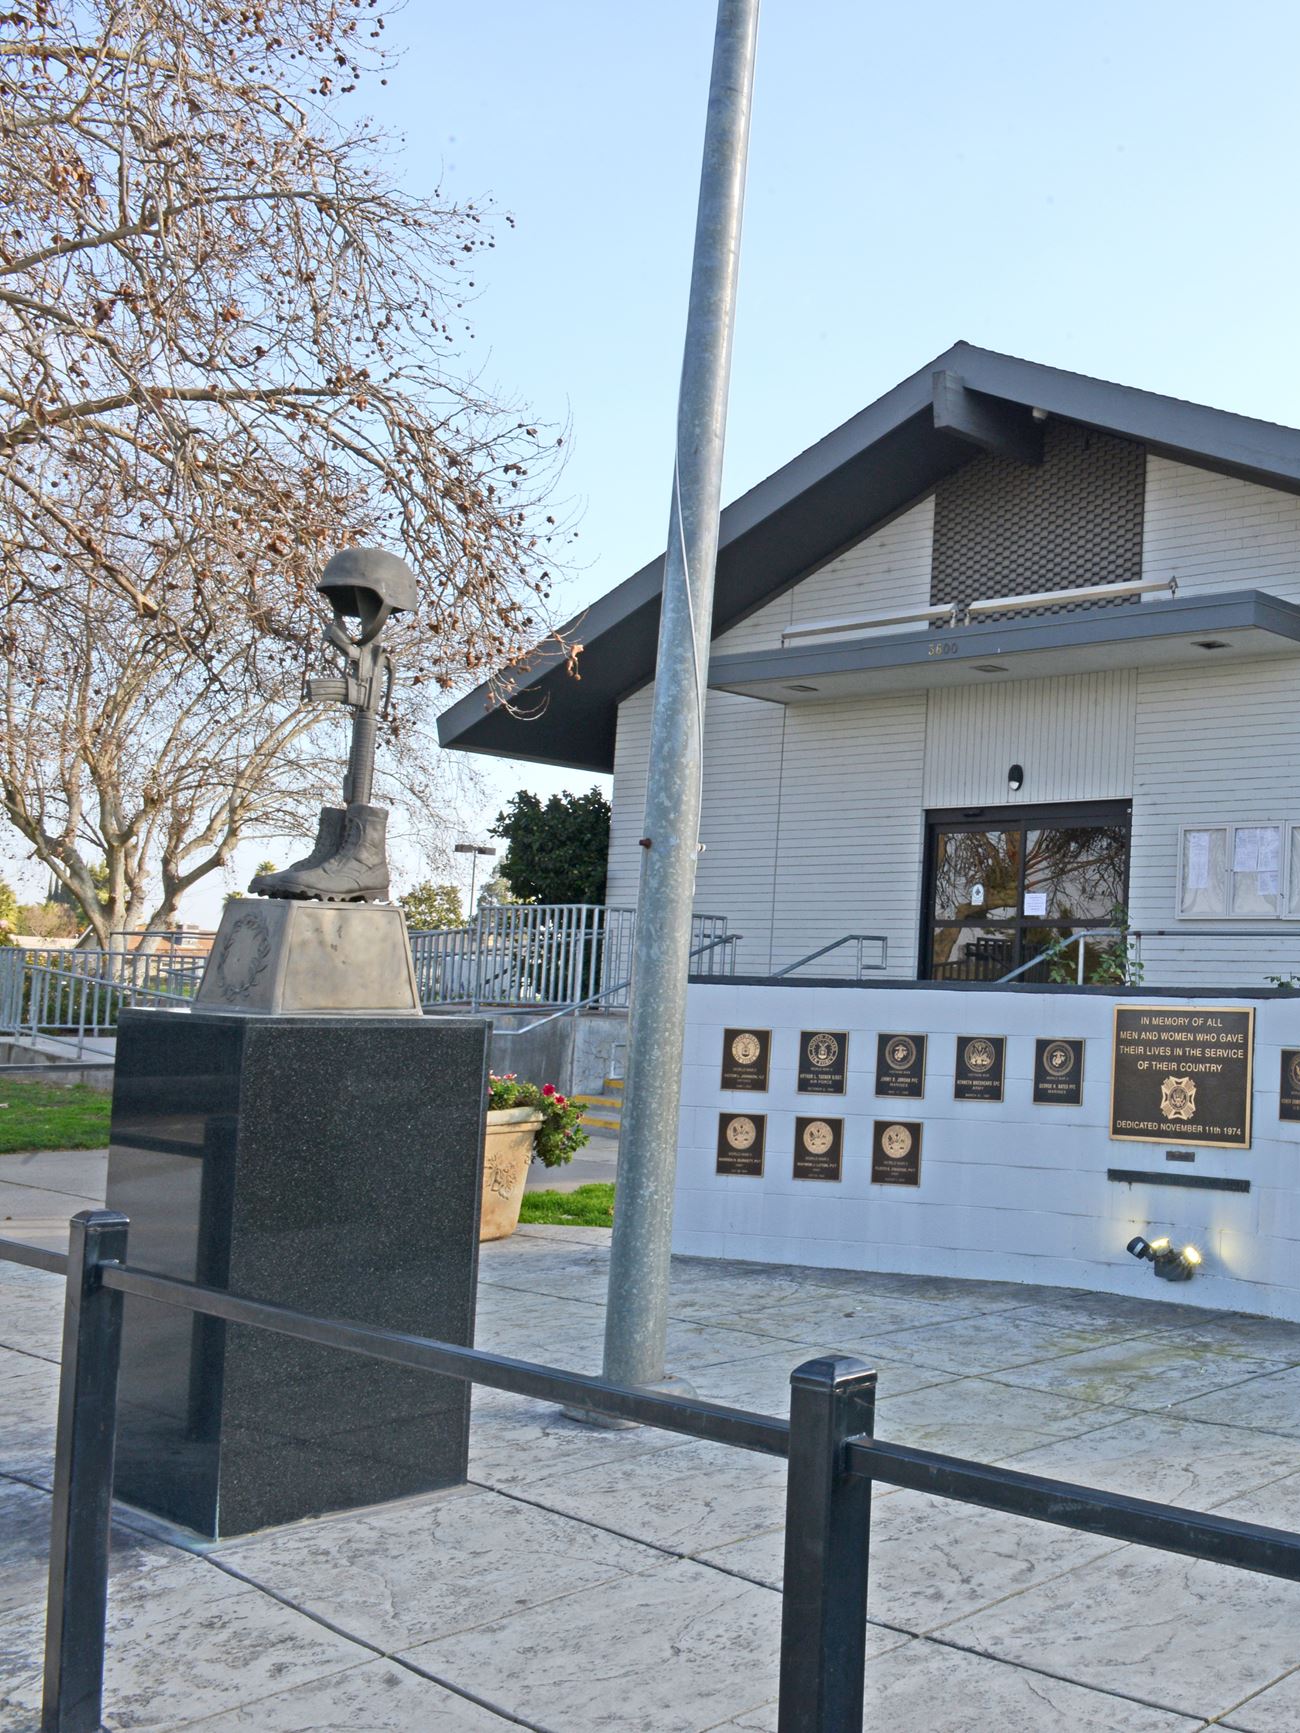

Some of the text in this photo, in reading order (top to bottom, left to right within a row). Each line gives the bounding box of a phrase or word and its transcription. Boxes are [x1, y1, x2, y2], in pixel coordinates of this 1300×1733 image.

[1141, 1017, 1222, 1027] IN MEMORY OF ALL
[1120, 1031, 1244, 1043] MEN AND WOMEN WHO GAVE
[1120, 1046, 1244, 1058] THEIR LIVES IN THE SERVICE
[1137, 1061, 1222, 1072] OF THEIR COUNTRY
[1117, 1121, 1158, 1129] DEDICATED
[1160, 1123, 1203, 1132] NOVEMBER
[1224, 1127, 1241, 1135] 1974
